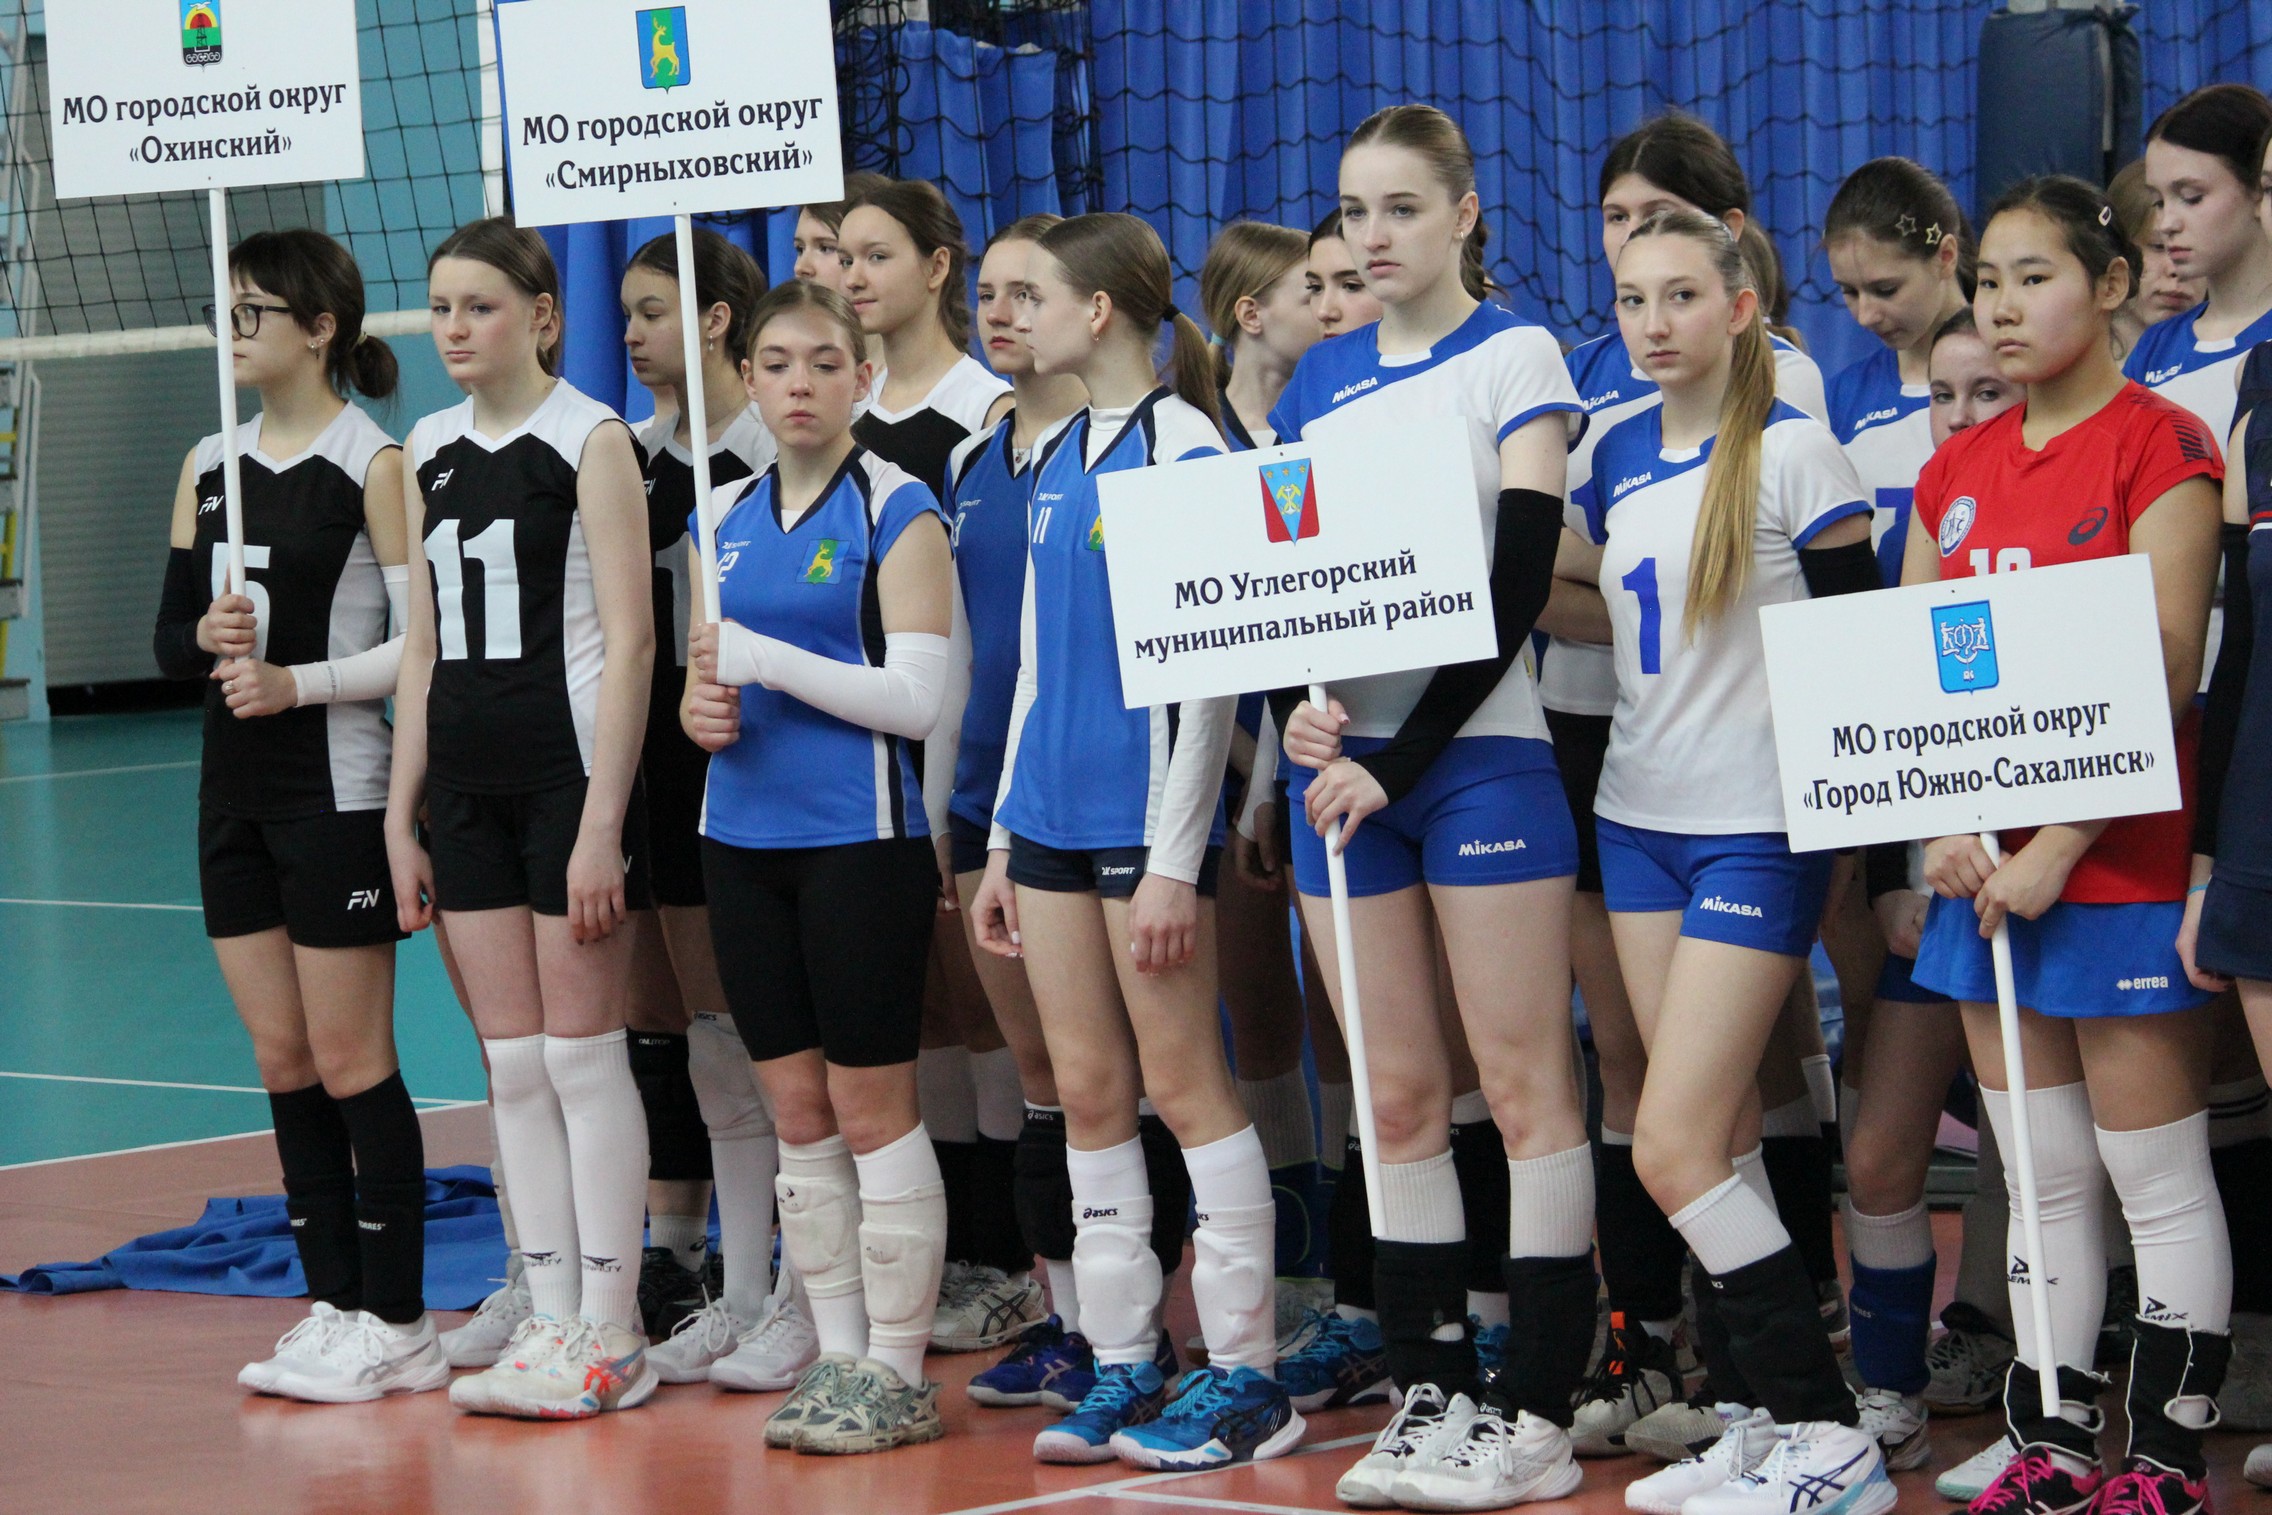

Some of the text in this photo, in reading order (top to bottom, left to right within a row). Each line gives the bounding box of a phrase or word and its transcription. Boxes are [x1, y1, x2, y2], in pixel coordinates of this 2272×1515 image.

[62, 83, 347, 127] МО городской округ
[523, 97, 823, 147] МО городской округ
[129, 127, 292, 164] «Охинский»
[545, 141, 813, 193] «Смирныховский»
[423, 518, 522, 661] 11
[1175, 548, 1417, 609] МО Углегорский
[1134, 590, 1475, 664] муниципальный район
[1621, 557, 1662, 675] 1
[1832, 702, 2111, 758] МО городской округ
[1803, 750, 2155, 816] «Город Южно-Сахалинск»
